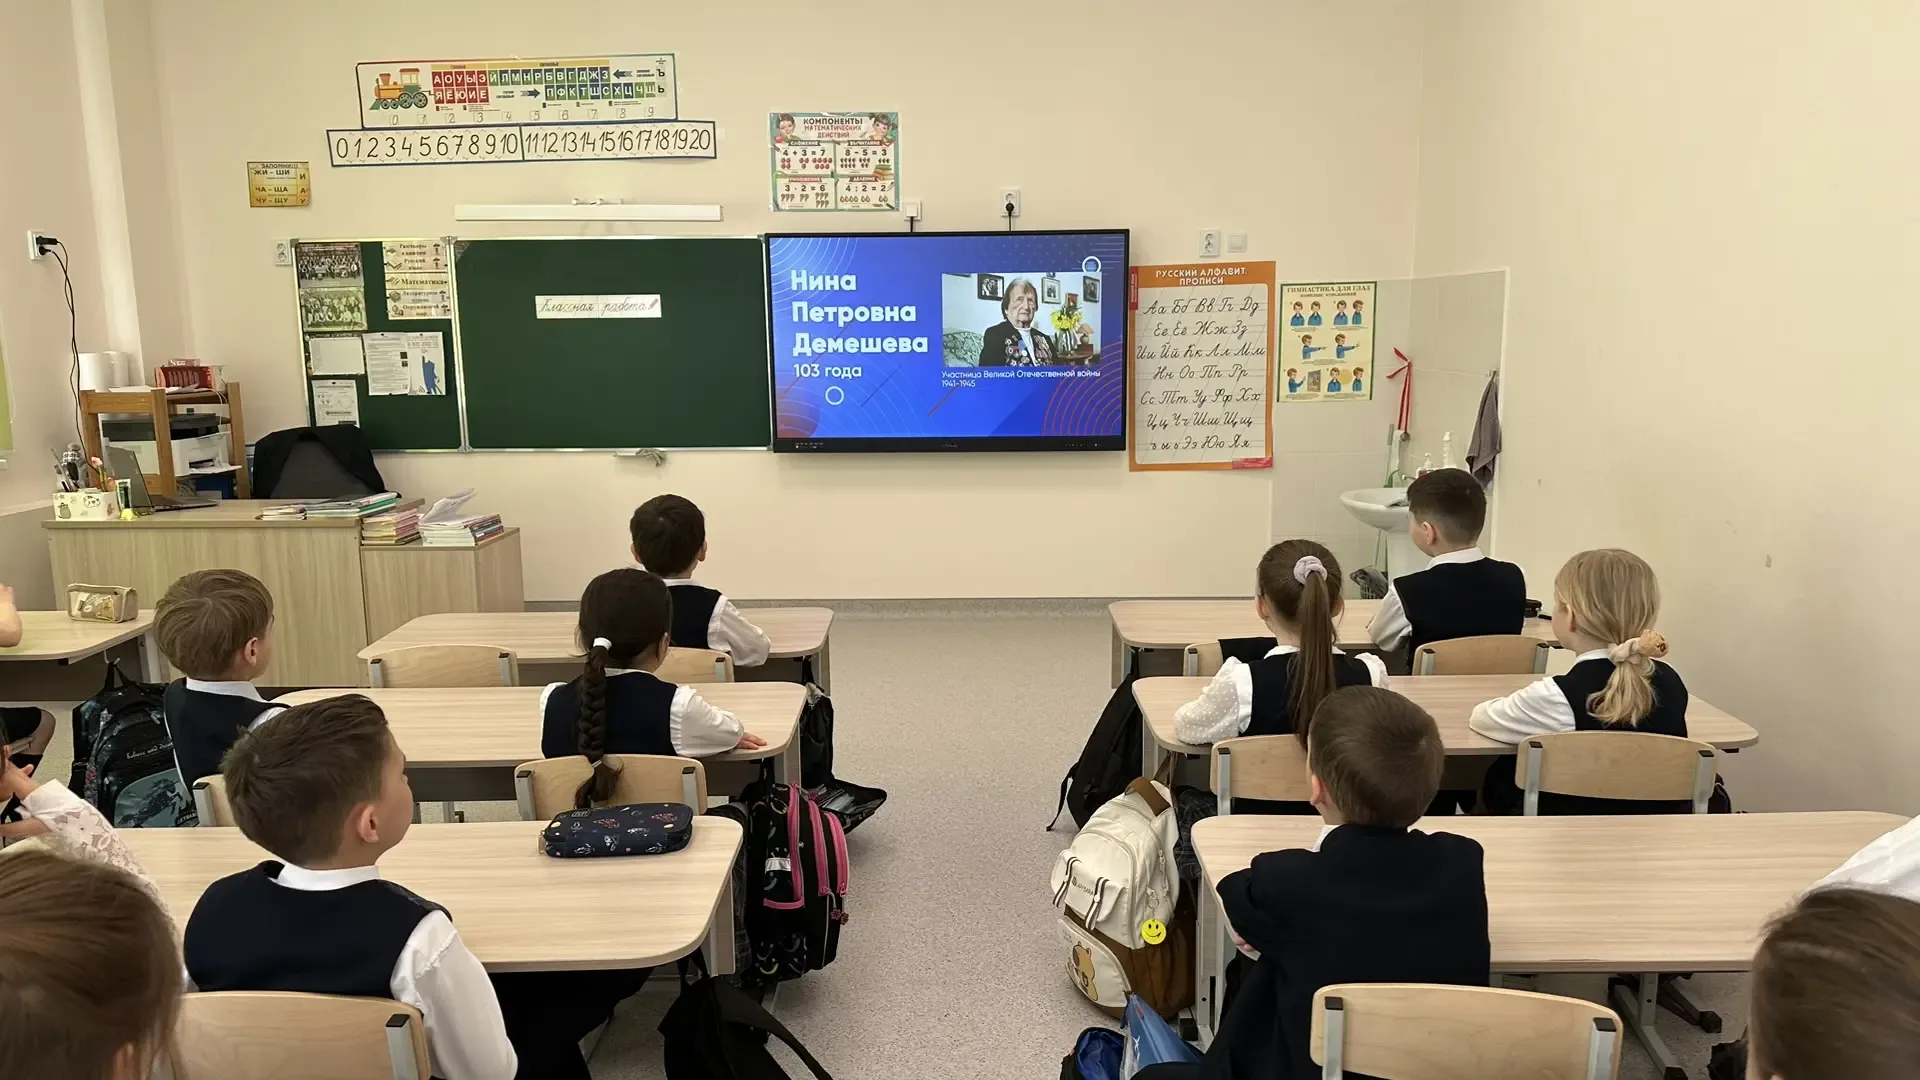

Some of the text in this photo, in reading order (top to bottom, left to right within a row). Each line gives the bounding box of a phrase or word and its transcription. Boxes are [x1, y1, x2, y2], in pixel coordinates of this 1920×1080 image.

[434, 74, 486, 84] А О У Ы Э
[501, 74, 509, 82] Л
[512, 72, 520, 82] М
[524, 72, 530, 81] Н
[535, 72, 541, 81] Р
[546, 71, 553, 81] Б
[557, 71, 564, 80] В
[568, 71, 574, 80] Г
[579, 70, 587, 81] Д
[589, 70, 599, 79] Ж
[602, 70, 608, 79] З
[436, 92, 442, 100] Я
[456, 91, 466, 99] Ю
[469, 91, 476, 99] И
[546, 88, 554, 97] П
[557, 88, 565, 96] Ф
[570, 88, 576, 96] К
[580, 88, 587, 96] Т
[590, 86, 600, 95] Ш
[602, 86, 610, 95] С
[614, 86, 621, 95] Х
[625, 86, 632, 95] Ц
[526, 129, 711, 153] 11 12 13 14 15 16 17 18 19 20
[817, 131, 850, 139] ДЕЙСТВИЙ
[336, 134, 518, 158] 0 1 2 3 4 5 6 7 8 9 10
[791, 269, 856, 290] Нина
[1156, 267, 1247, 278] РУССКИЙ АЛФАВИТ.
[1180, 277, 1224, 286] ПРОПИСИ
[541, 297, 646, 316] Классная работа
[792, 301, 916, 327] Петровна
[1143, 296, 1259, 317] Аа Бб Вв Гг Дд
[1154, 322, 1168, 336] Ее
[1193, 321, 1228, 335] Жж
[1232, 320, 1248, 340] Зз
[793, 332, 928, 357] Демешева
[1137, 341, 1266, 359] Ии Йй Кк Лл Мм
[793, 364, 862, 379] 103 года
[941, 369, 1100, 379] Участница Великой Отечественной войны
[1153, 364, 1248, 382] Нн Оо Пп Рр
[1140, 388, 1261, 408] Сс Тт Уу Фф Хх
[1147, 412, 1253, 430] Цц Чч Шш Щщ
[1182, 436, 1197, 449] Ээ
[1201, 435, 1224, 449] Юю
[1228, 434, 1249, 448] Яя
